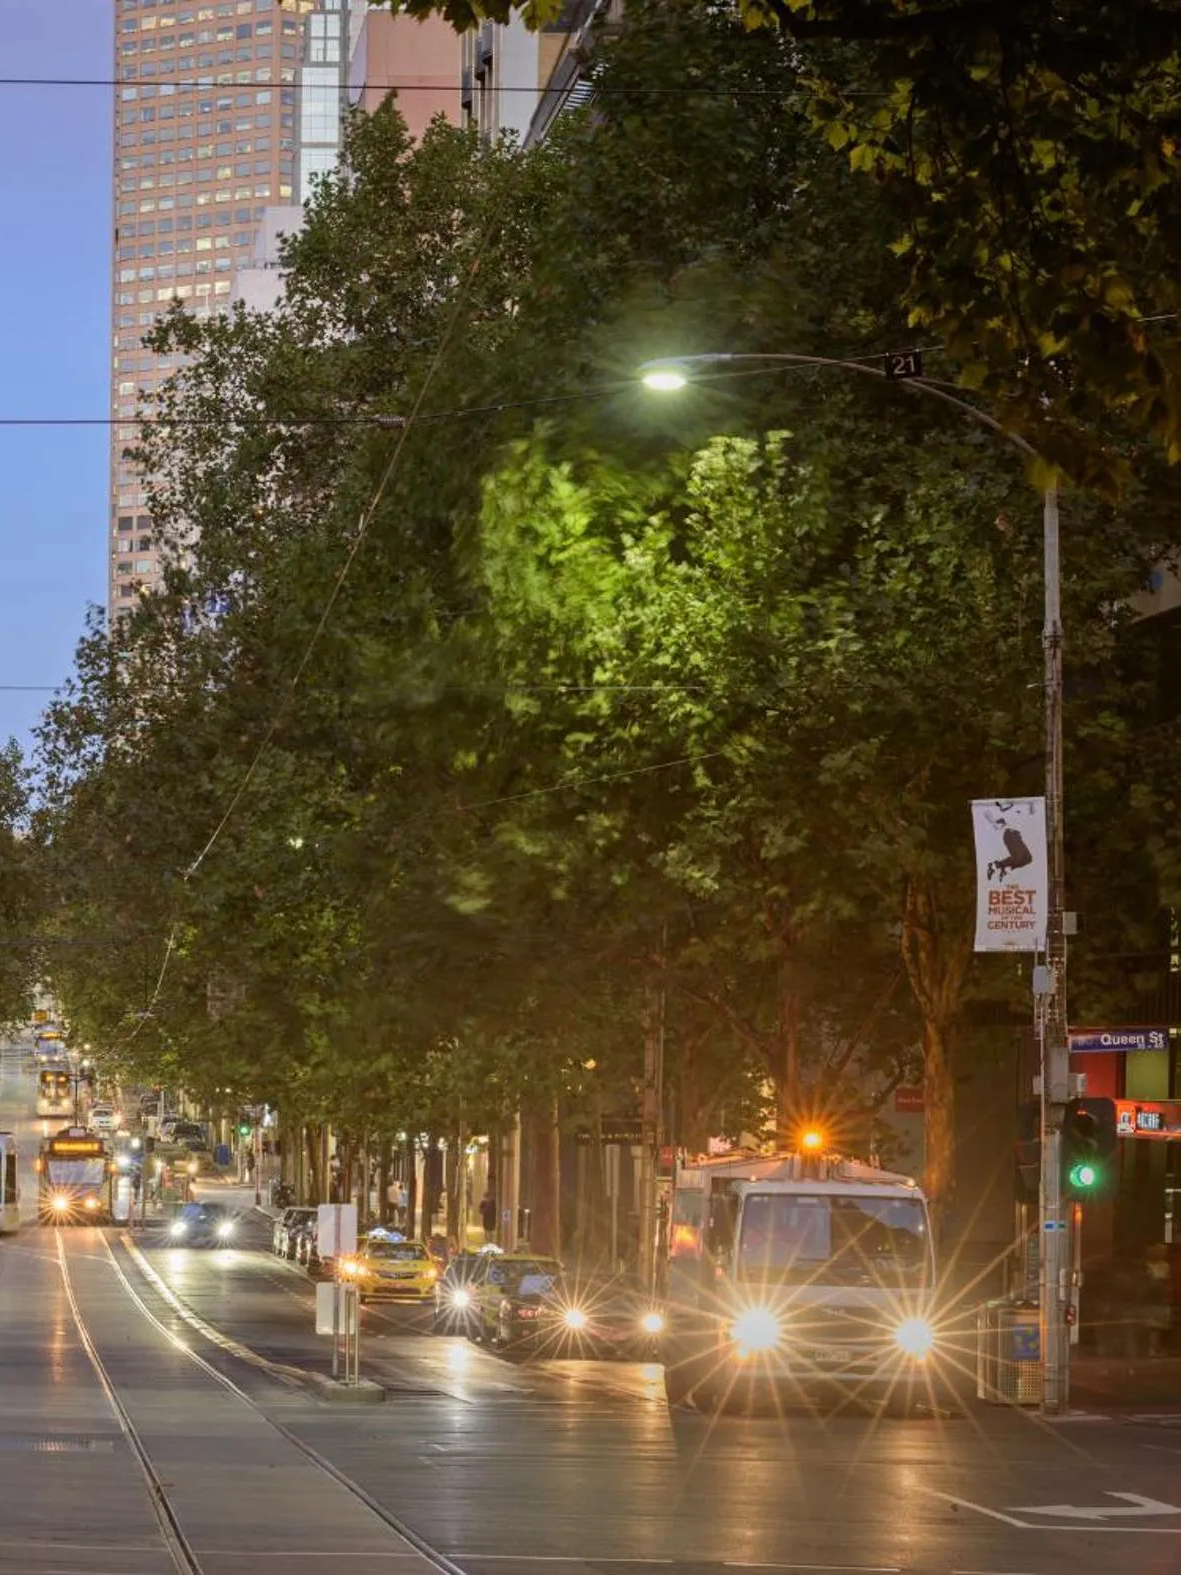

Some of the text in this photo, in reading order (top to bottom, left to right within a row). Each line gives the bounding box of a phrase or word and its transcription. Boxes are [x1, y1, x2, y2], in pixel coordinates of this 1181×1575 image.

[892, 356, 915, 375] 21
[989, 890, 1037, 905] BEST
[988, 905, 1036, 915] MUSICAL
[987, 921, 1036, 930] CENTURY
[1100, 1033, 1145, 1046] Queen
[1149, 1031, 1164, 1044] St
